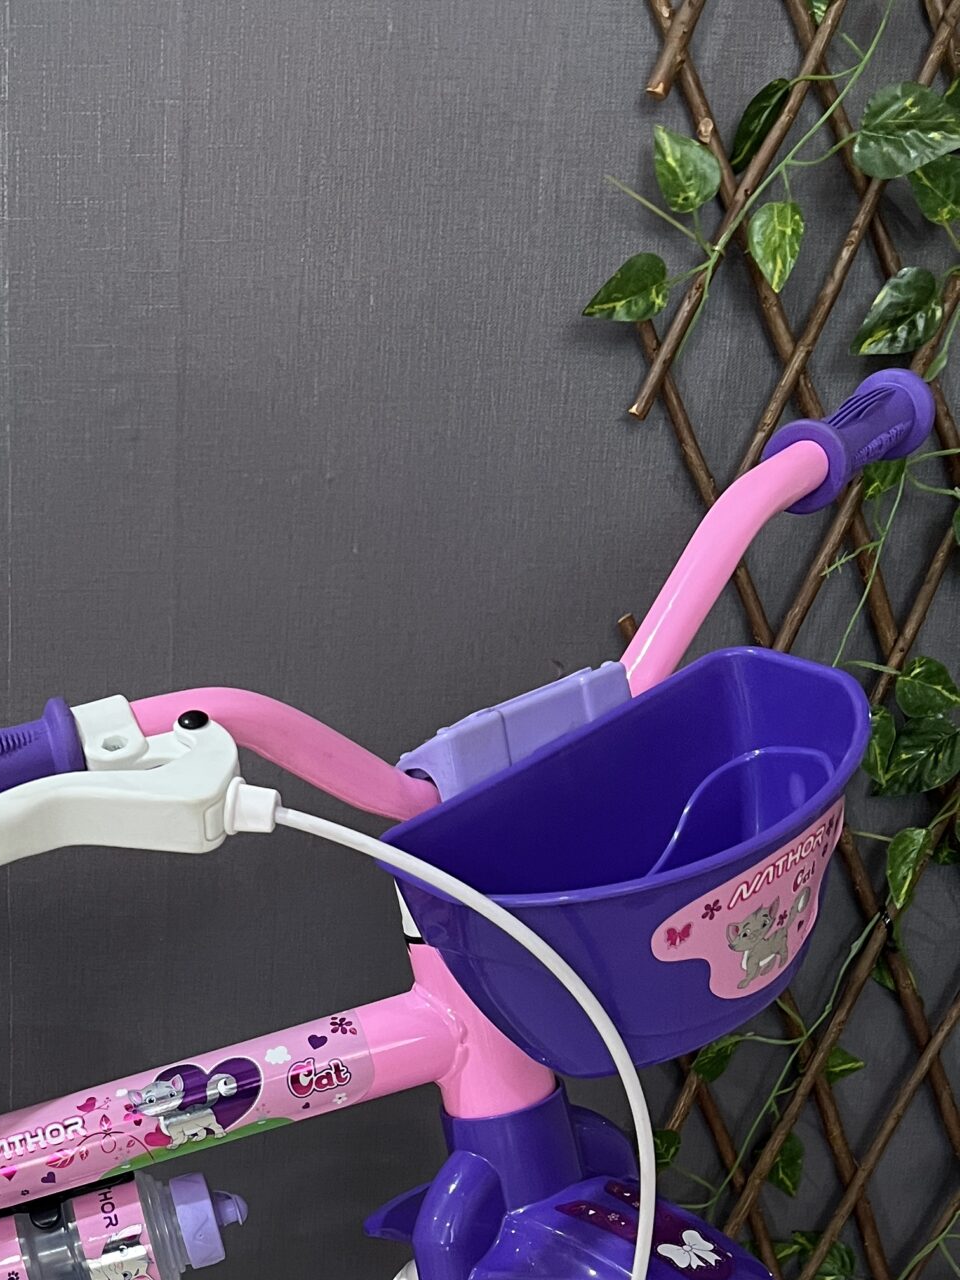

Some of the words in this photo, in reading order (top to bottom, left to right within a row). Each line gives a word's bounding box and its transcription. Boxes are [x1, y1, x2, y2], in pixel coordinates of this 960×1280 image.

[729, 824, 826, 909] NATHOR
[792, 860, 816, 893] Cat
[287, 1057, 352, 1098] Cat
[98, 1186, 120, 1230] HOR
